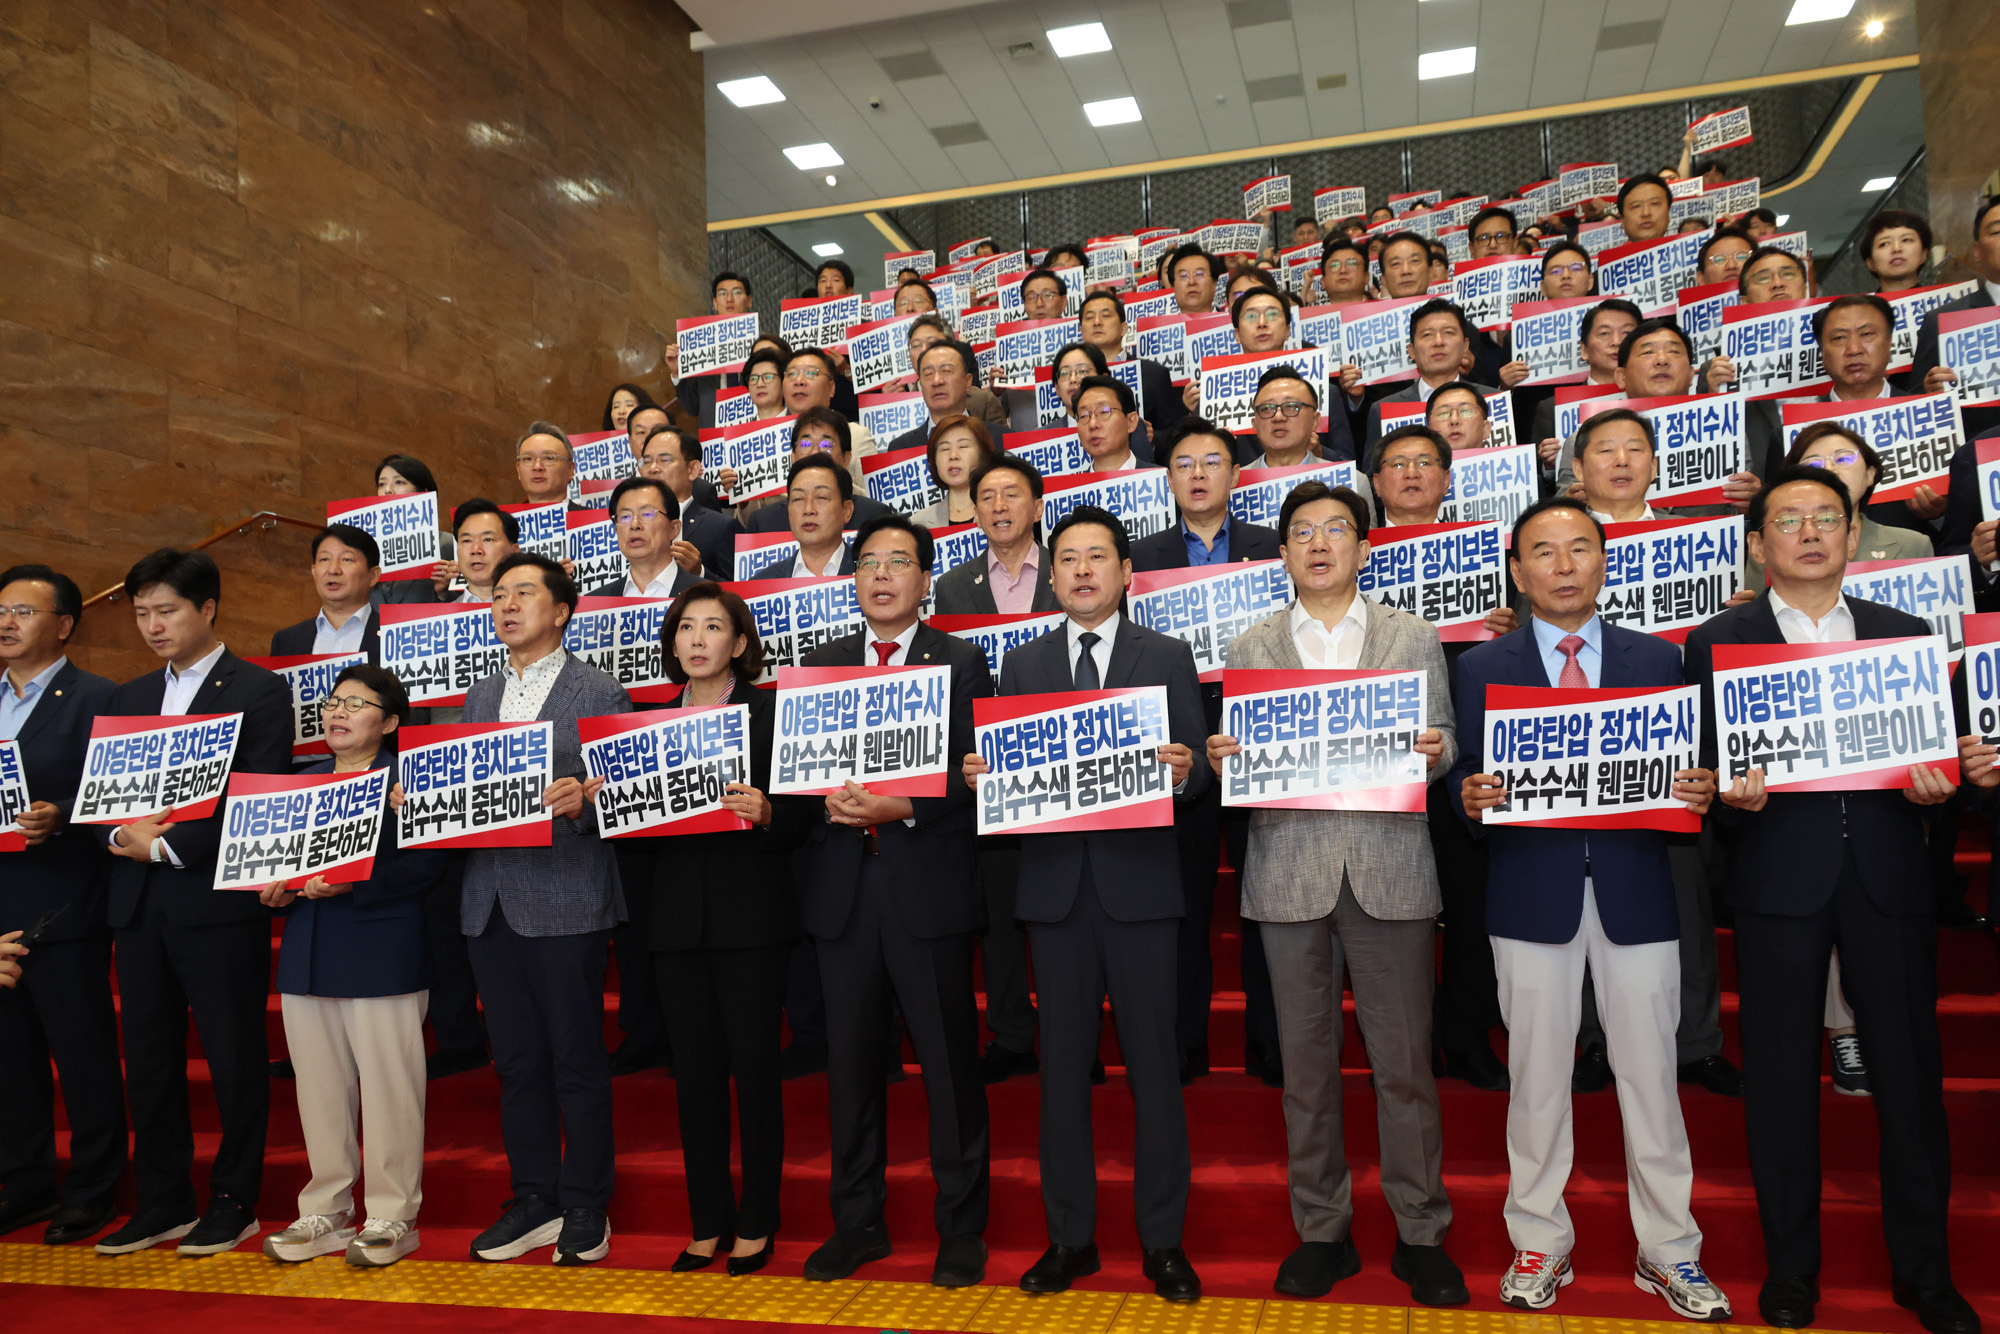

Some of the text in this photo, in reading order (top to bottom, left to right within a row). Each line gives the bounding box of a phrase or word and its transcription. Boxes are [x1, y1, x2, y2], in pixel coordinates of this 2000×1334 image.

[997, 252, 1022, 273] 정치보복
[1507, 263, 1543, 291] 정치수
[1602, 251, 1655, 292] 야당탄압
[975, 276, 996, 294] 수수색
[783, 298, 859, 331] 야당탄압 정치보복
[1463, 294, 1501, 324] 수수색
[679, 317, 756, 352] 야당탄압 정치보복
[852, 330, 890, 363] 야당탄압
[998, 331, 1042, 361] 야당탄압
[1139, 325, 1184, 357] 야당탄압
[1346, 312, 1399, 352] 야당탄압
[1516, 311, 1573, 350] 야당탄압
[1727, 317, 1795, 358] 야당탄압
[680, 347, 716, 374] 압수수색
[855, 354, 894, 387] 압수수색
[1206, 366, 1262, 400] 야당탄압
[864, 405, 911, 435] 야당탄압
[1667, 401, 1739, 448] 정치수사
[1872, 396, 1955, 448] 정치보복
[704, 443, 725, 469] 야당
[729, 431, 776, 468] 야당탄압
[1667, 441, 1739, 488] 웬말이냐
[868, 462, 920, 502] 야당탄압
[1106, 472, 1170, 517] 정치수사
[1461, 453, 1531, 498] 정치수사
[381, 499, 433, 536] 정치수사
[1227, 483, 1282, 523] 당탄압
[382, 530, 435, 567] 웬말이냐
[1357, 527, 1499, 591] 당탄압 정치보복
[1605, 526, 1738, 587] 탄압 정치수사
[1134, 564, 1290, 633] 야당탄압 정치보복
[1422, 571, 1502, 622] 중단하라
[385, 620, 450, 662] 야당탄압
[620, 606, 668, 645] 정치보
[455, 648, 510, 689] 중단하
[618, 645, 667, 683] 중단하
[761, 636, 795, 677] 수색
[781, 676, 944, 736] 야당탄압 정치수사
[1722, 667, 1823, 725] 야당탄압
[1829, 647, 1939, 711] 정치수사
[1230, 677, 1420, 745] 야당탄압 정치보복
[1492, 697, 1694, 763] 야당탄압 정치수사
[90, 719, 238, 776] 야당탄압 정치보복
[589, 709, 744, 784] 야당탄압 정치보복
[778, 723, 943, 784] 압수수색 웬말이냐
[982, 694, 1163, 774] 야당탄압 정치보복
[1727, 720, 1829, 780] 압수수색
[1835, 701, 1947, 766] 웬말이냐
[402, 728, 547, 794] 야당탄압 정치보복
[1230, 741, 1320, 796] 압수수색
[80, 773, 161, 816] 압수수색
[162, 758, 228, 806] 중단하라
[600, 756, 745, 830] 압수수색 중단하라
[984, 745, 1167, 825] 압수수색 중단하라
[229, 774, 385, 838] 야당탄압 정치보복
[401, 773, 546, 840] 압수수색 중단하라
[222, 815, 378, 881] 압수수색 중단하라
